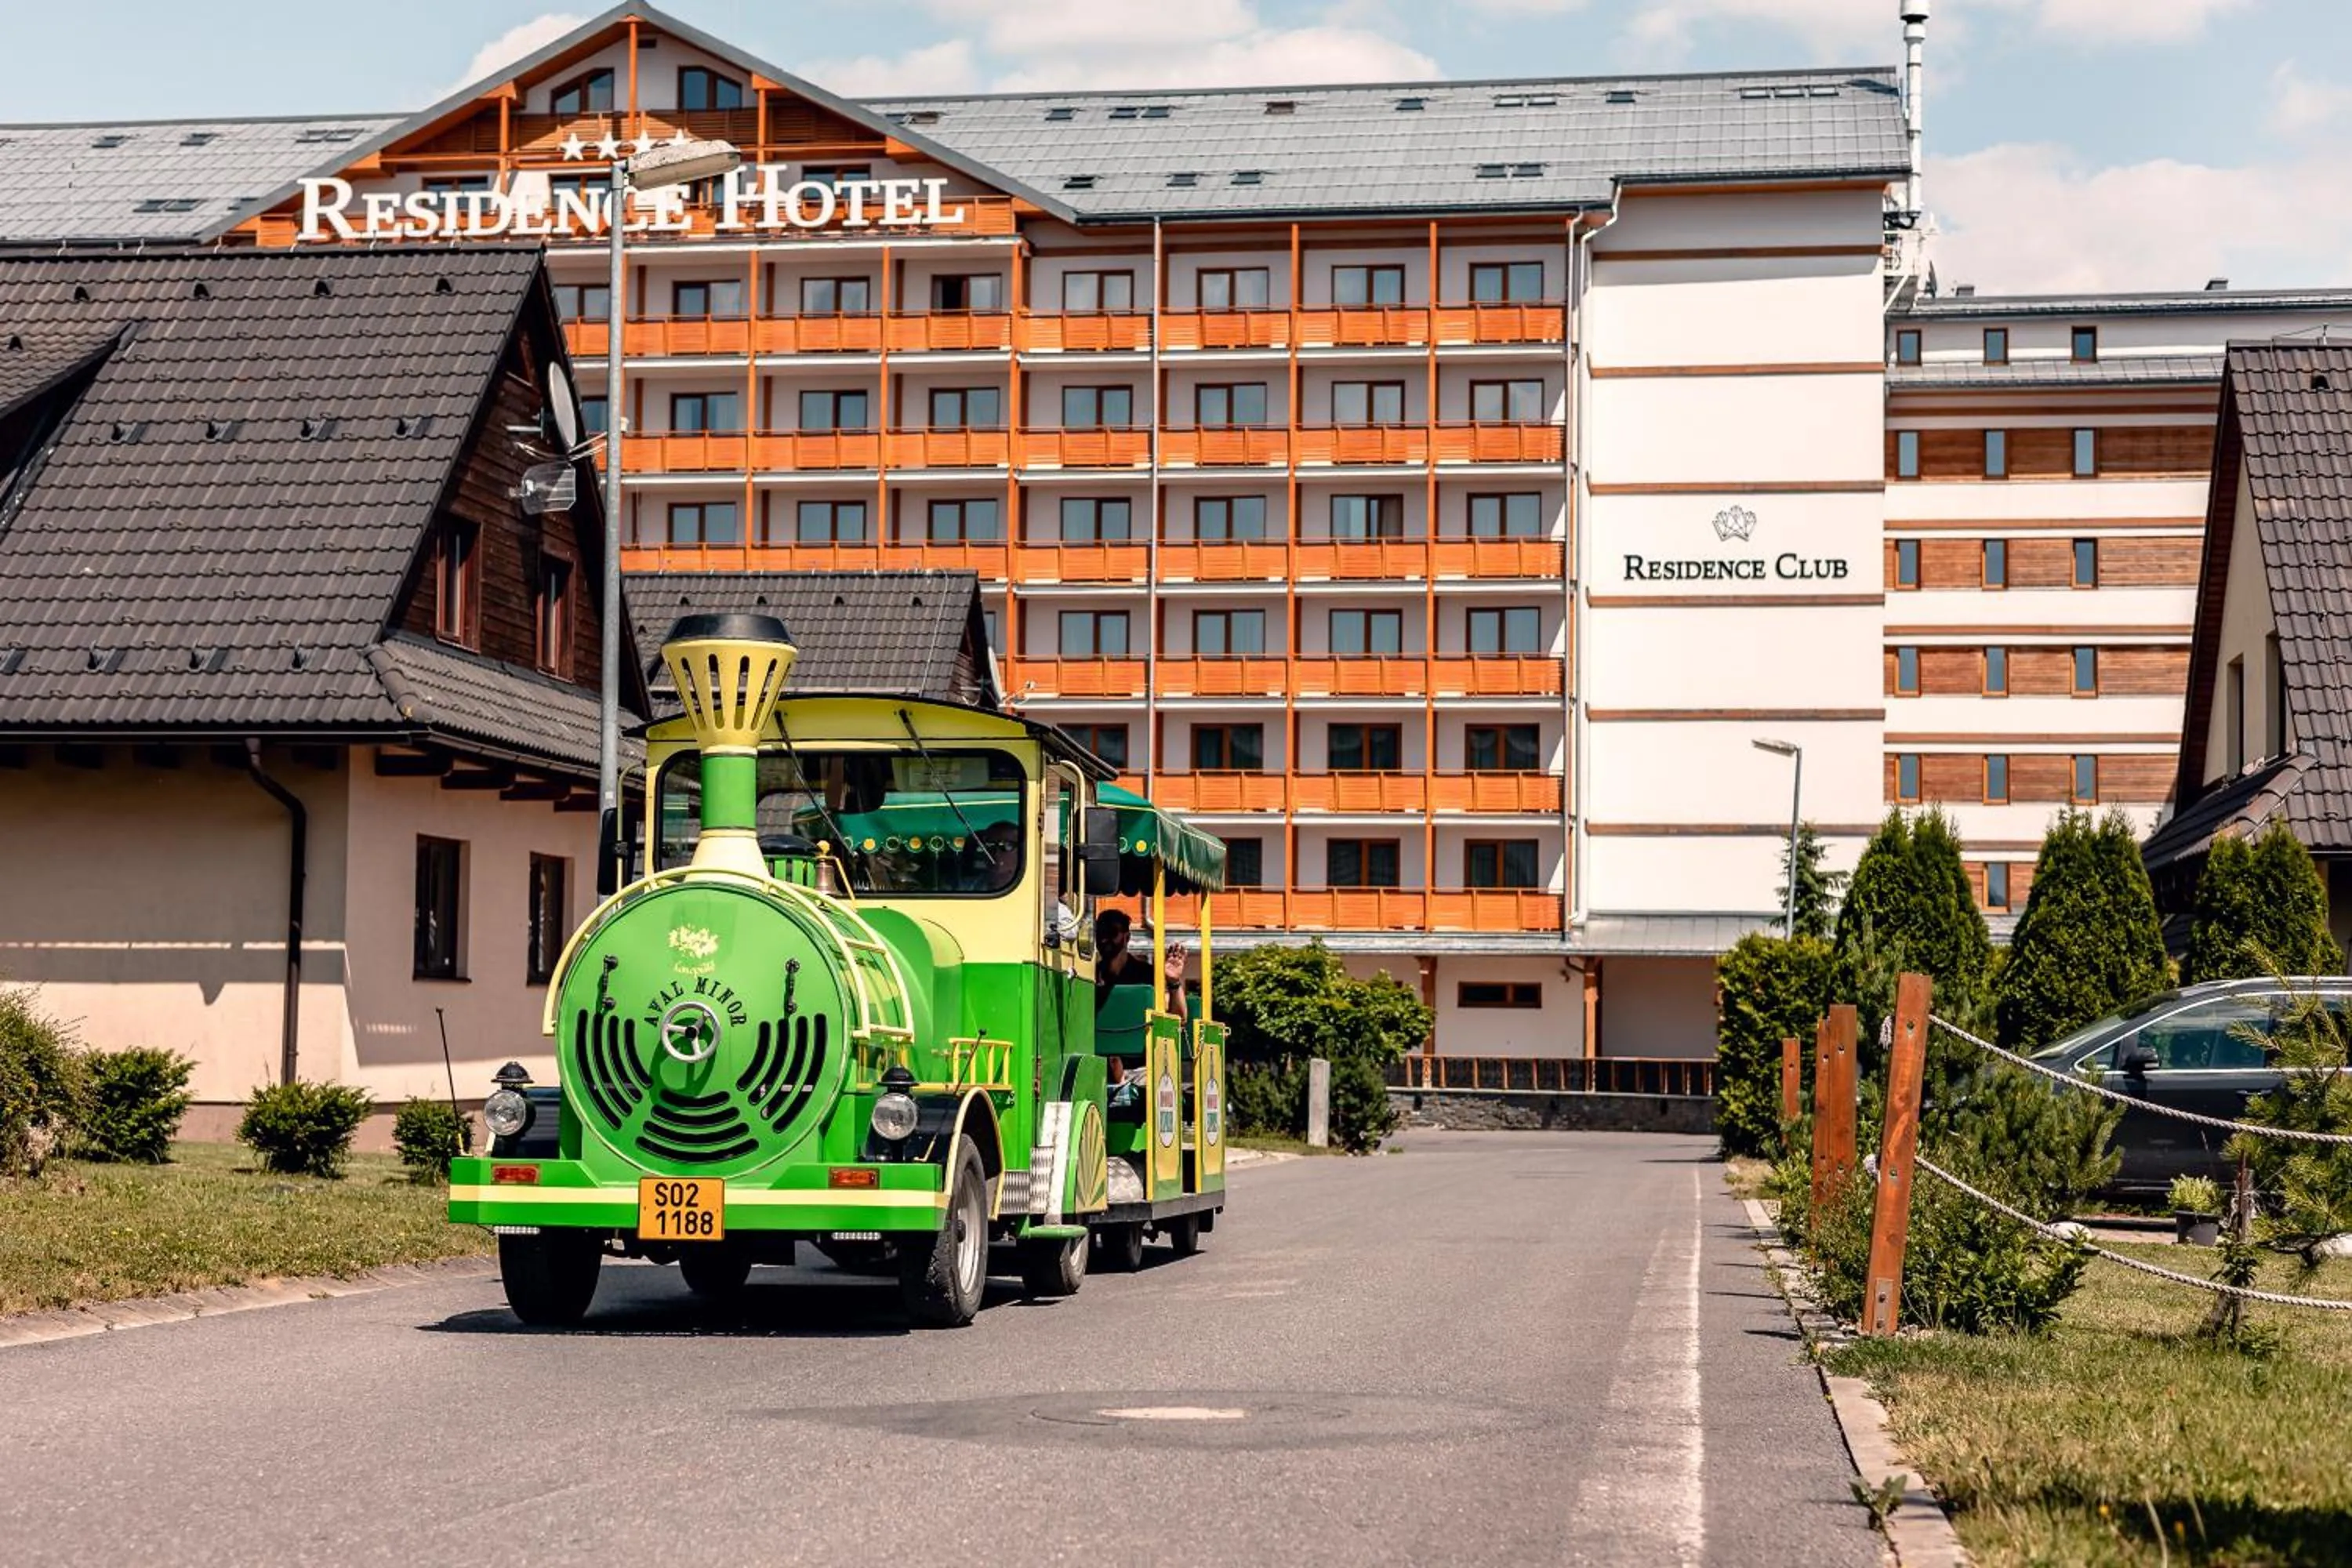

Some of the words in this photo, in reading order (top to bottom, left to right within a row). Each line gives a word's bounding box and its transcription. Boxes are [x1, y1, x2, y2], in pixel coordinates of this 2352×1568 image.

[297, 176, 691, 239] RESIDENCE
[714, 164, 964, 229] HOTEL
[1624, 554, 1766, 580] RESIDENCE
[1775, 553, 1849, 579] CLUB
[644, 981, 684, 1028] AVAL
[694, 976, 747, 1027] MINOR
[655, 1210, 713, 1236] 1188
